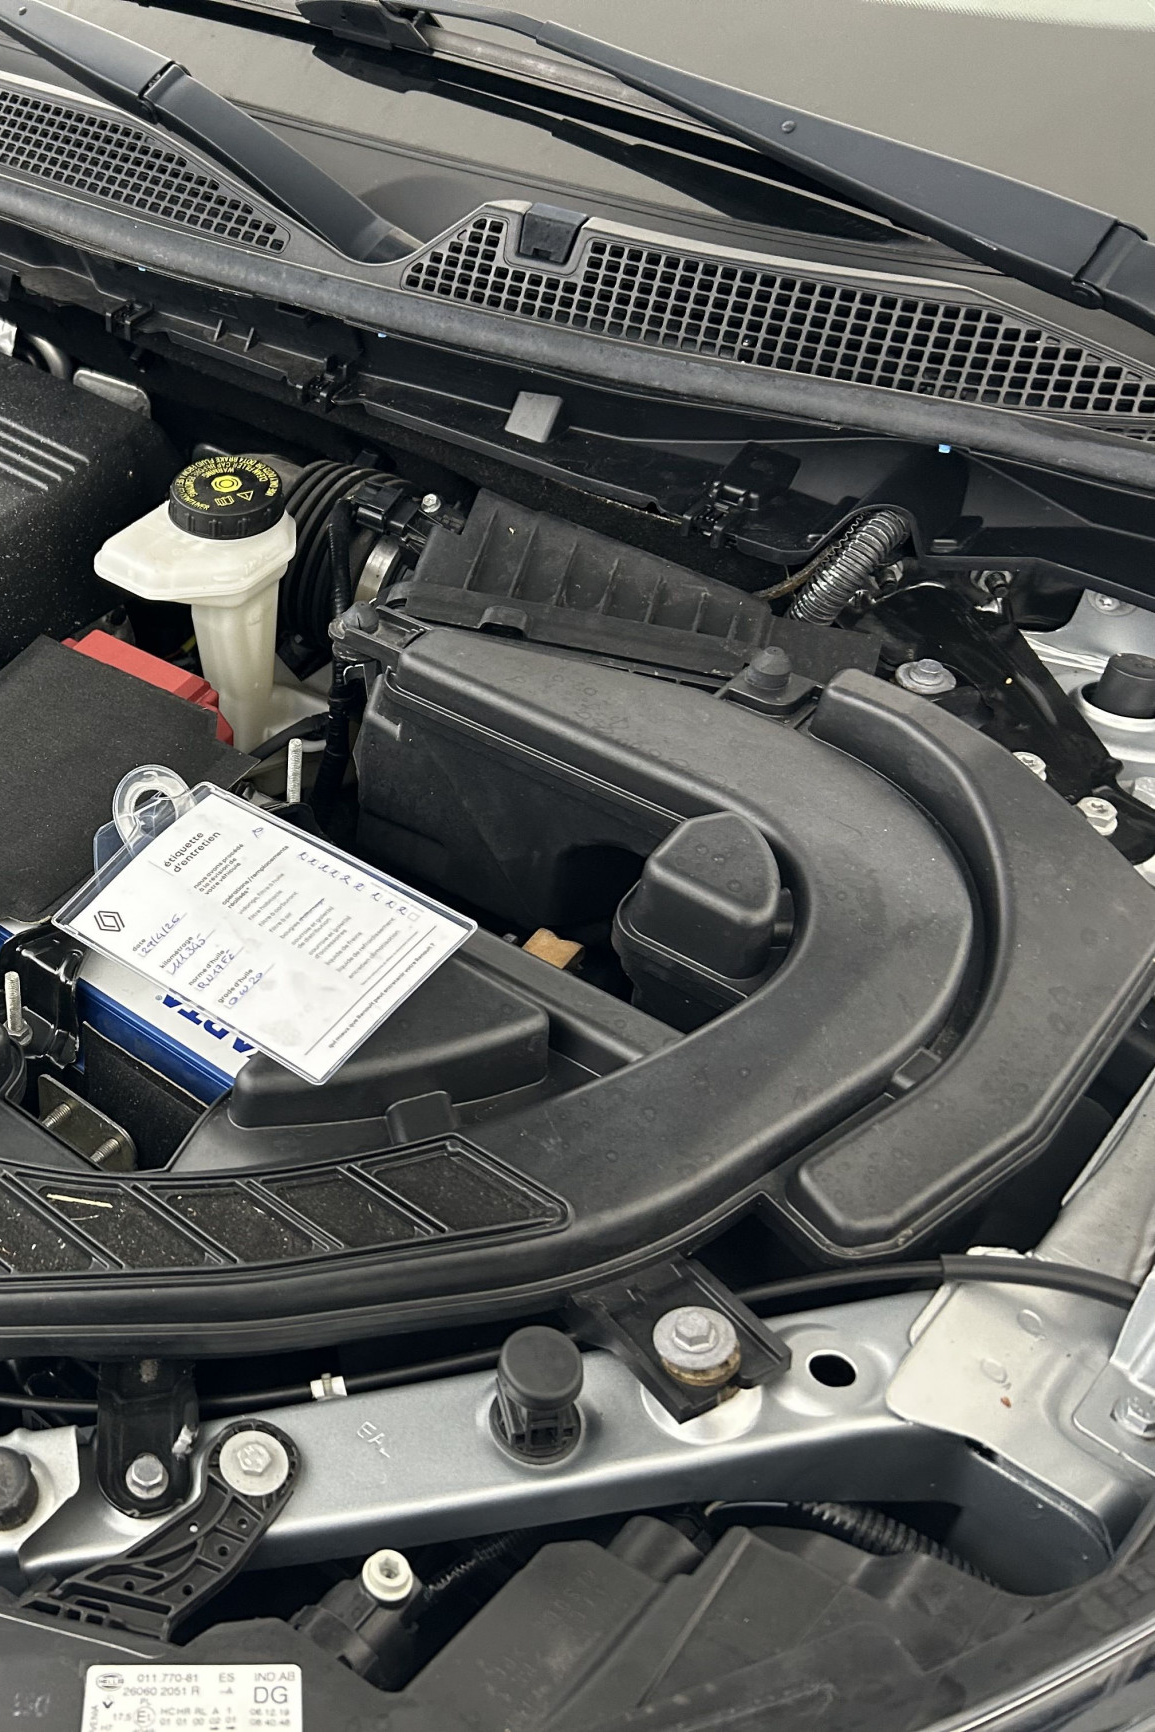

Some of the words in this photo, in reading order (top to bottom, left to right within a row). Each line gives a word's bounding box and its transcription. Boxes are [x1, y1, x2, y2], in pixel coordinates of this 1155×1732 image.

[195, 458, 215, 468] FLUID
[216, 461, 231, 469] CAP
[164, 832, 204, 868] étiquette
[174, 832, 221, 873] d'entretien
[193, 876, 208, 889] nous
[206, 862, 224, 877] avons
[222, 844, 244, 864] procédé
[204, 882, 220, 895] votre
[132, 938, 146, 952] date
[159, 936, 194, 969] kilométrage
[188, 968, 208, 986] norme
[206, 950, 225, 969] d'huile
[218, 987, 236, 1004] grade
[234, 969, 254, 988] d'huile
[219, 1671, 235, 1683] ES
[253, 1686, 288, 1704] DG
